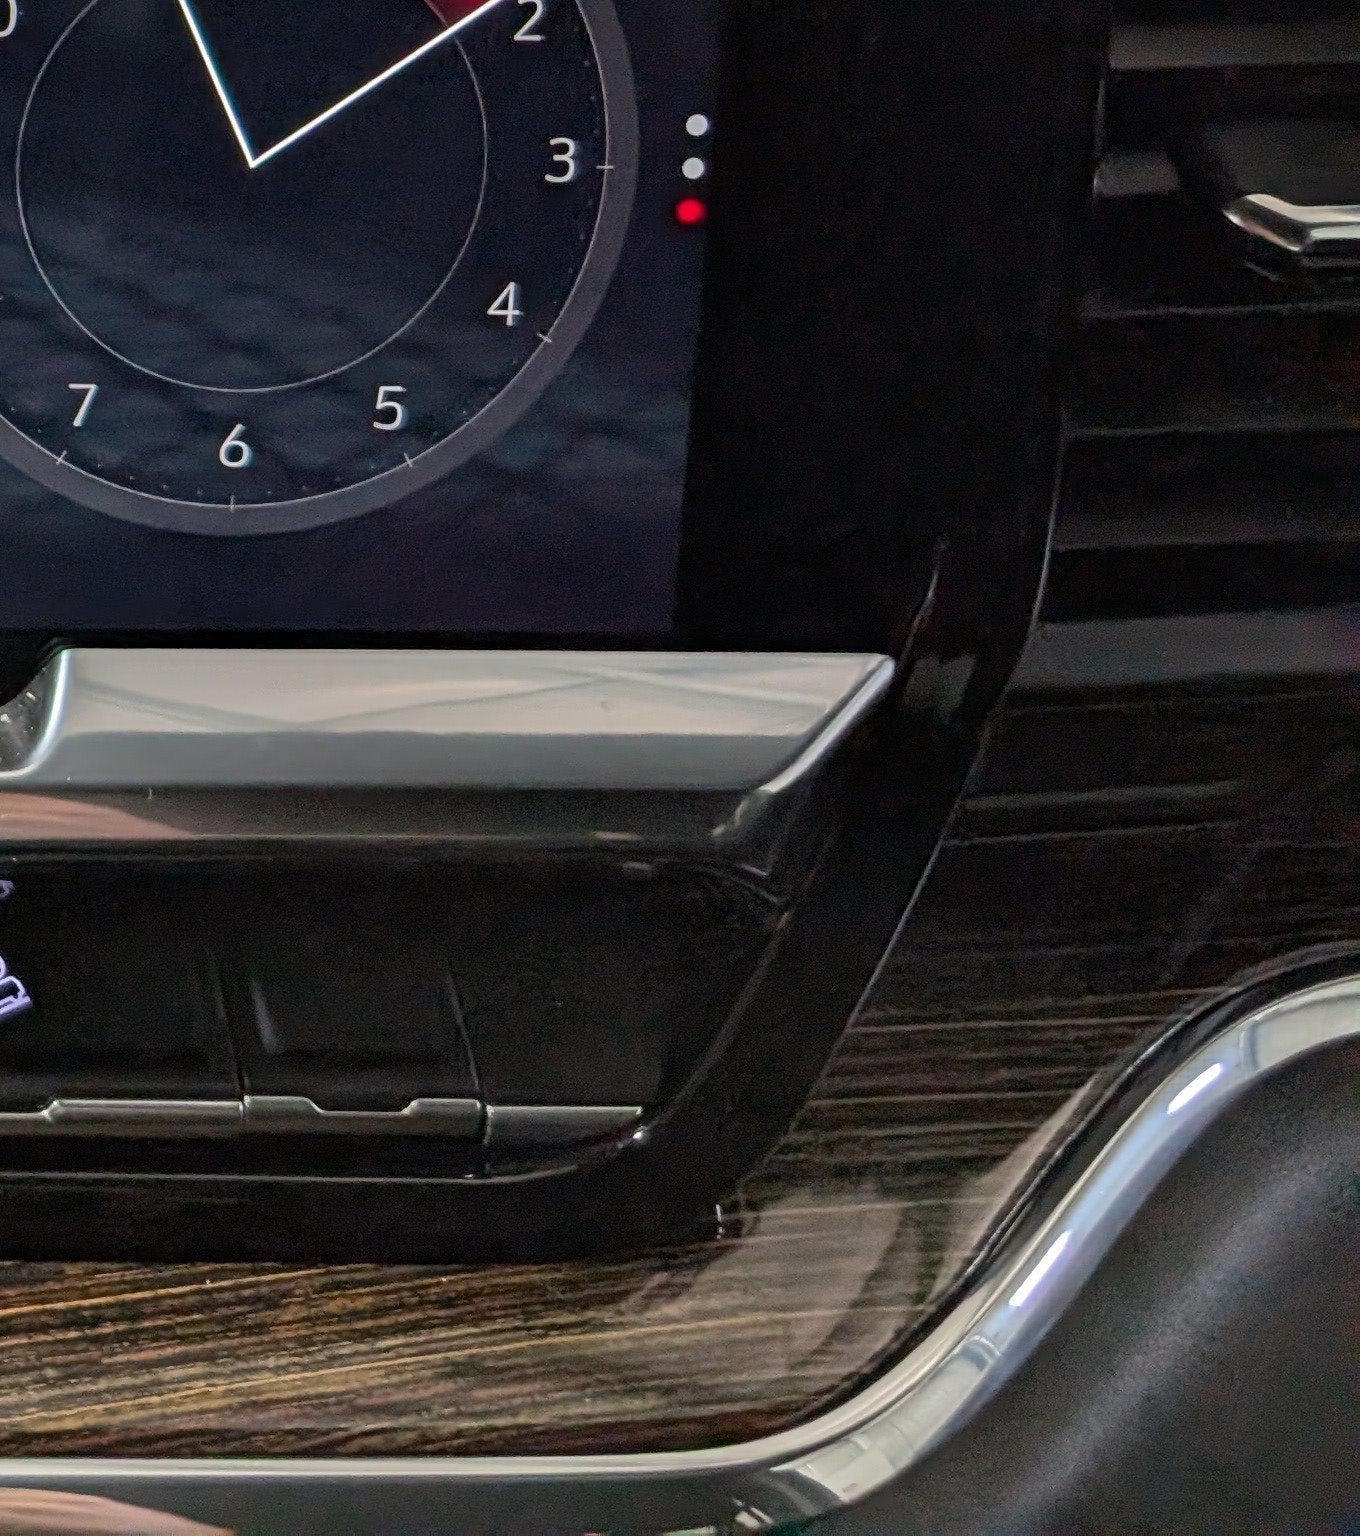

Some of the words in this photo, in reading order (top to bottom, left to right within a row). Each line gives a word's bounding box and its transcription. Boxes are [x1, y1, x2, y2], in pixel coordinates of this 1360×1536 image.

[544, 137, 577, 183] 3
[486, 281, 523, 327] 4
[68, 383, 99, 427] 7
[373, 385, 407, 431] 5
[219, 423, 252, 468] 6
